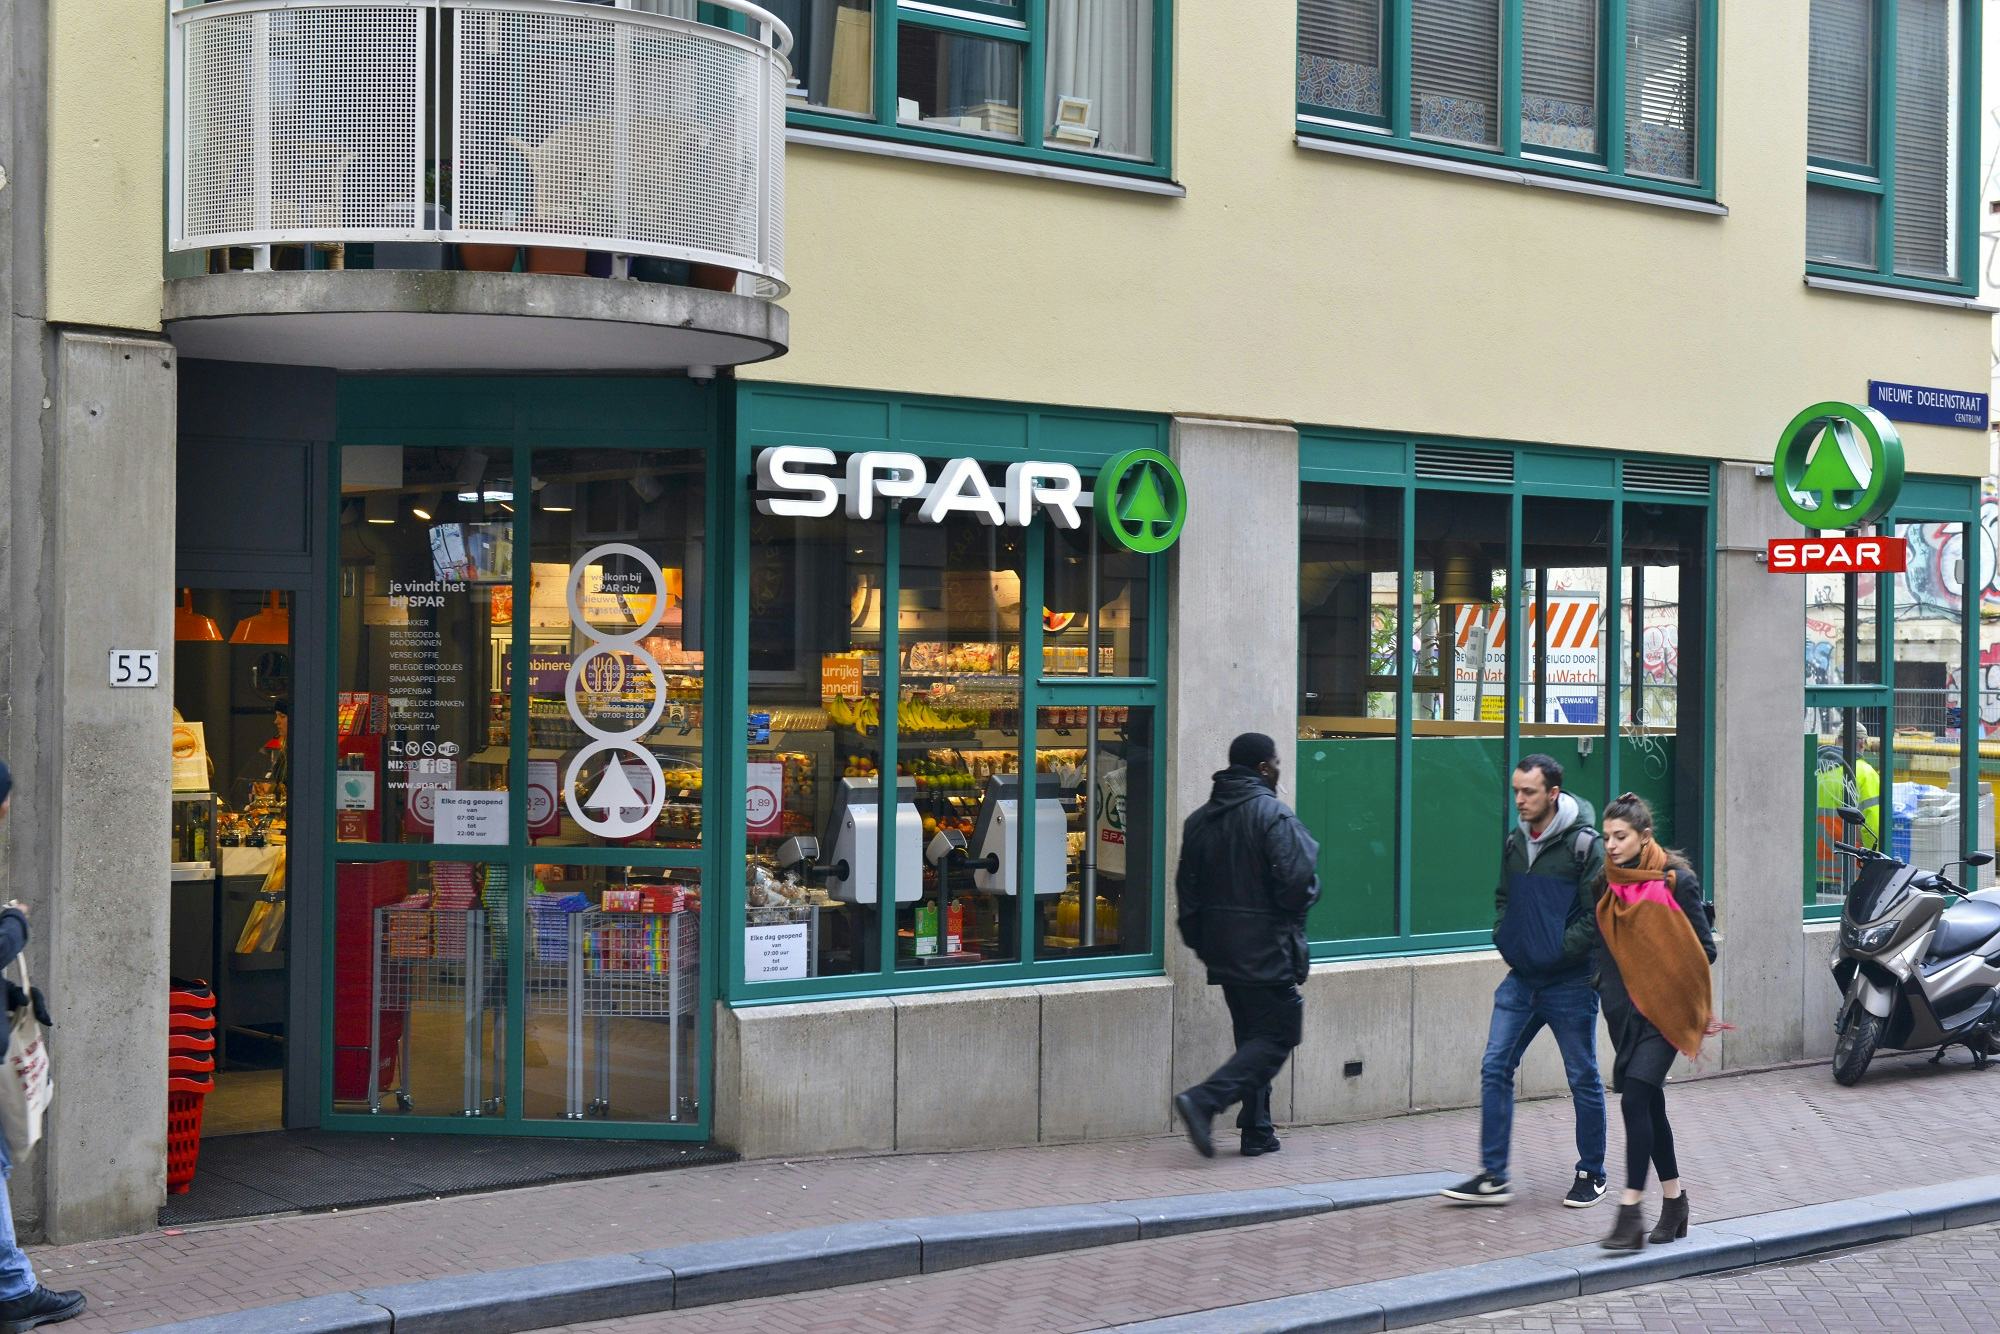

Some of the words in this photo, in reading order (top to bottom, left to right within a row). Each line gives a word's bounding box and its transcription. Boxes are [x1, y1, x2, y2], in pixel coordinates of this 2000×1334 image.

[1878, 387, 1912, 404] NIEUWE
[1917, 391, 1982, 411] DOELENSTRAAT
[1955, 413, 1981, 424] CENTRUM
[757, 446, 1082, 530] SPAR
[1773, 543, 1880, 567] SPAR
[591, 573, 627, 581] welkom
[630, 573, 642, 583] bij
[388, 580, 402, 594] je
[404, 580, 440, 592] vindt
[443, 580, 466, 592] het
[593, 584, 619, 592] SPAR
[621, 584, 640, 594] city
[409, 596, 445, 607] SPAR
[1573, 655, 1597, 664] DOOR
[117, 655, 152, 682] 55
[1455, 695, 1475, 703] CAMER
[388, 780, 452, 791] www.spar.nl
[458, 798, 471, 806] dag
[1103, 831, 1125, 844] SPA
